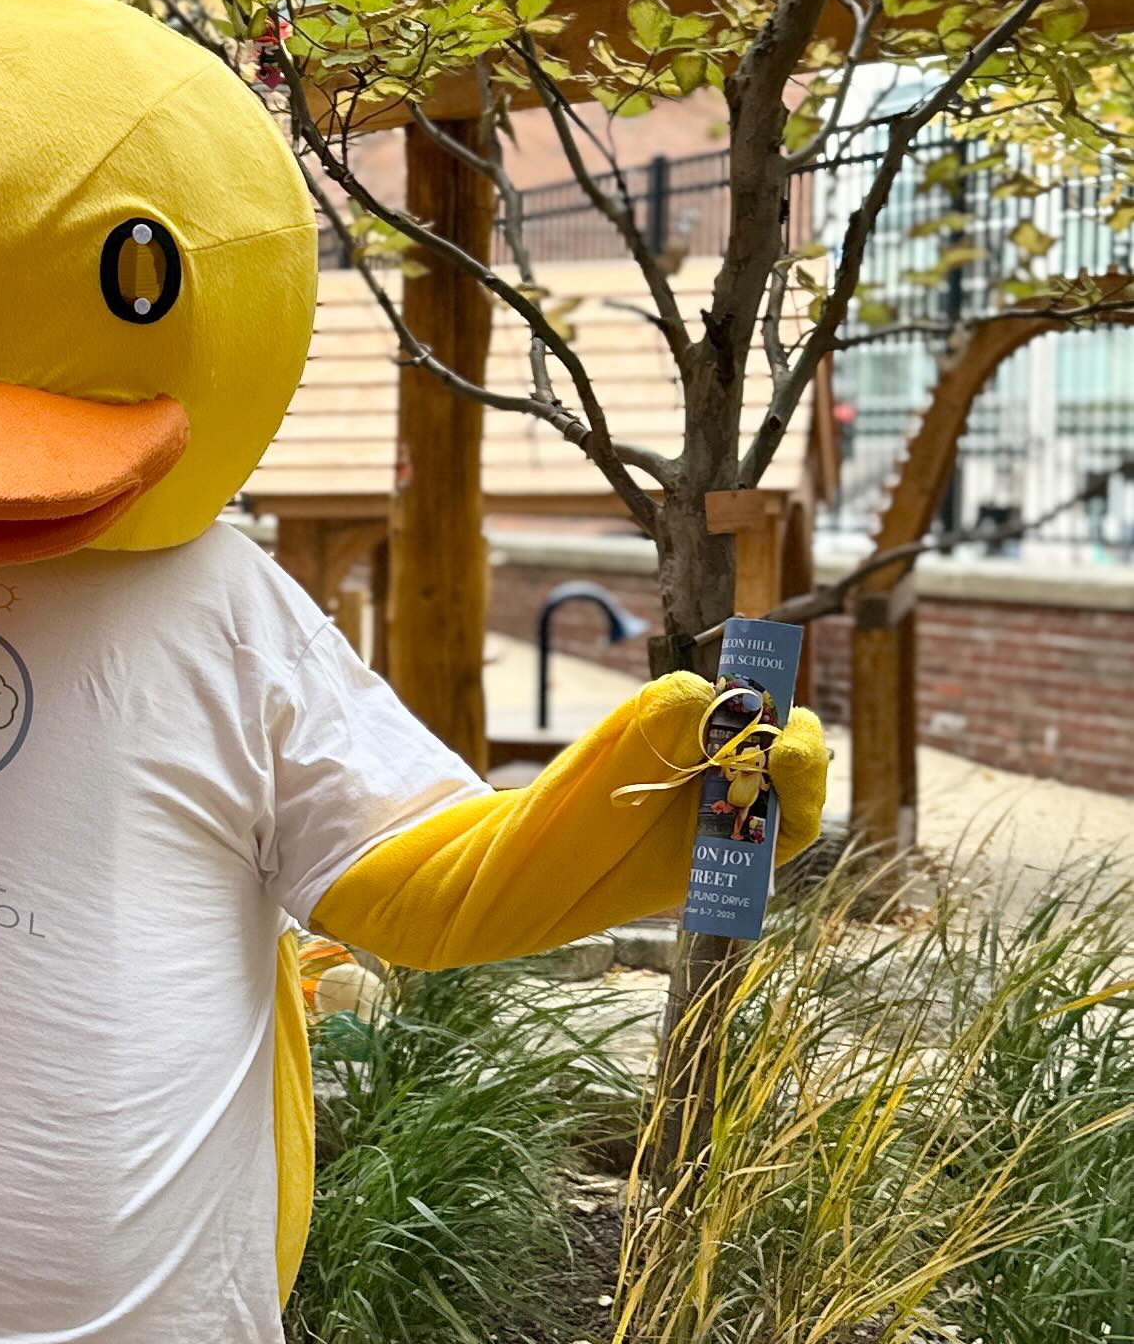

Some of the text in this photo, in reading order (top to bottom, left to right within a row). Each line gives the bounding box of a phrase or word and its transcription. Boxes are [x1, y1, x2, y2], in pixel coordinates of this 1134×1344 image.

[747, 639, 776, 652] HILL
[737, 654, 785, 670] SCHOOL
[696, 845, 719, 862] ON
[722, 849, 754, 866] JOY
[693, 890, 719, 903] FUND
[721, 894, 751, 907] DRIVE
